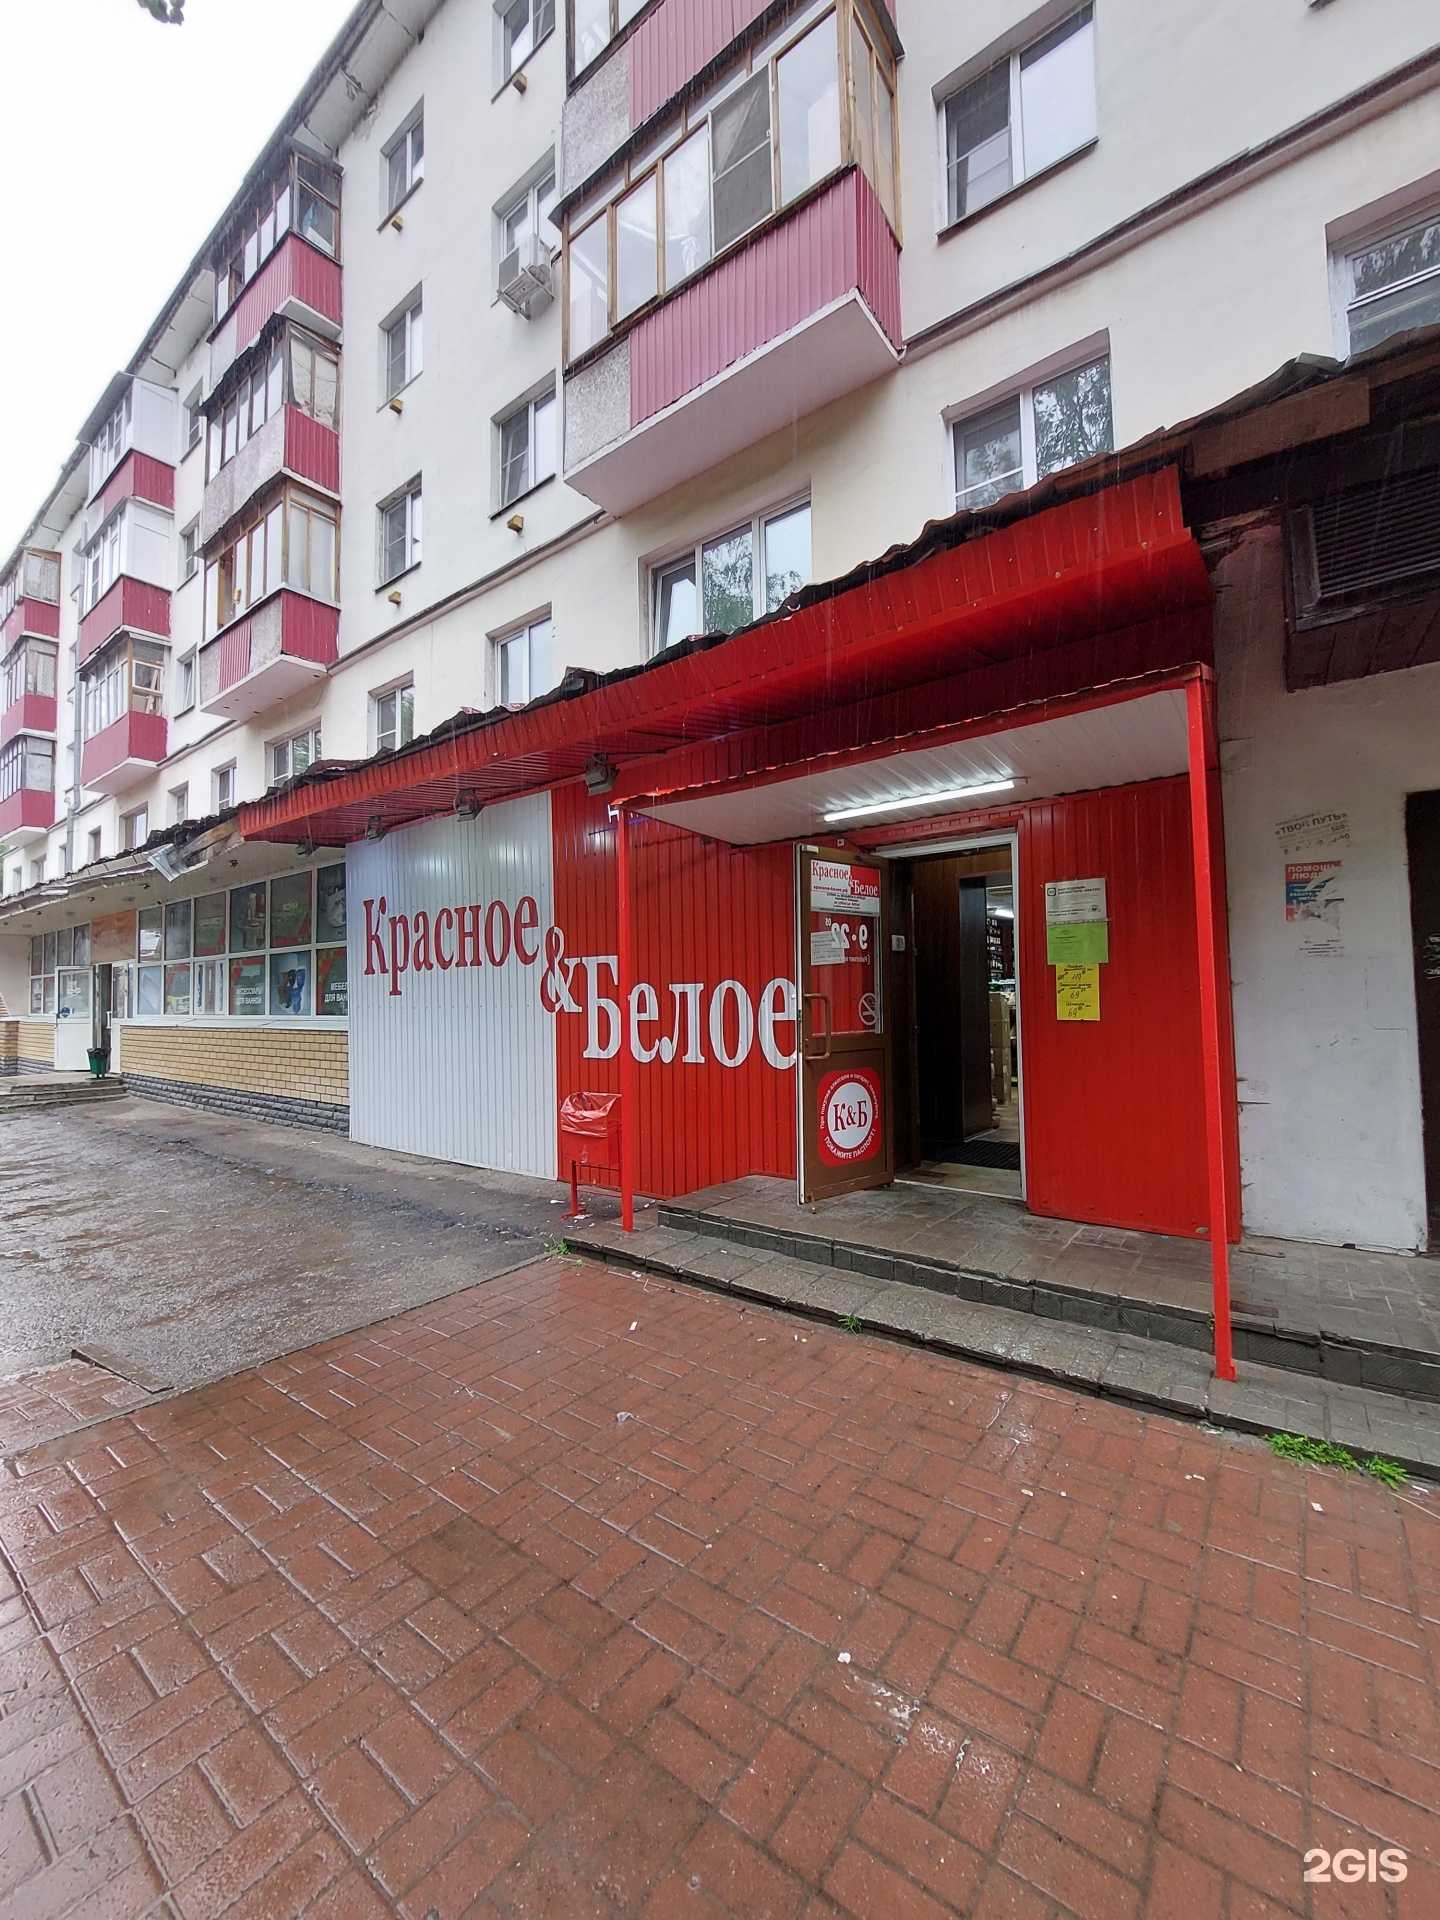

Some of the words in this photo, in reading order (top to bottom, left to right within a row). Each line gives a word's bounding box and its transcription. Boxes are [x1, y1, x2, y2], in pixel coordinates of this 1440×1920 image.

[812, 860, 848, 881] Красное
[853, 879, 879, 897] Белое
[330, 983, 347, 991] МЕБЕ
[363, 896, 540, 996] Красное
[540, 926, 583, 1014] &
[582, 955, 797, 1070] Белое
[833, 1099, 868, 1131] К&Б
